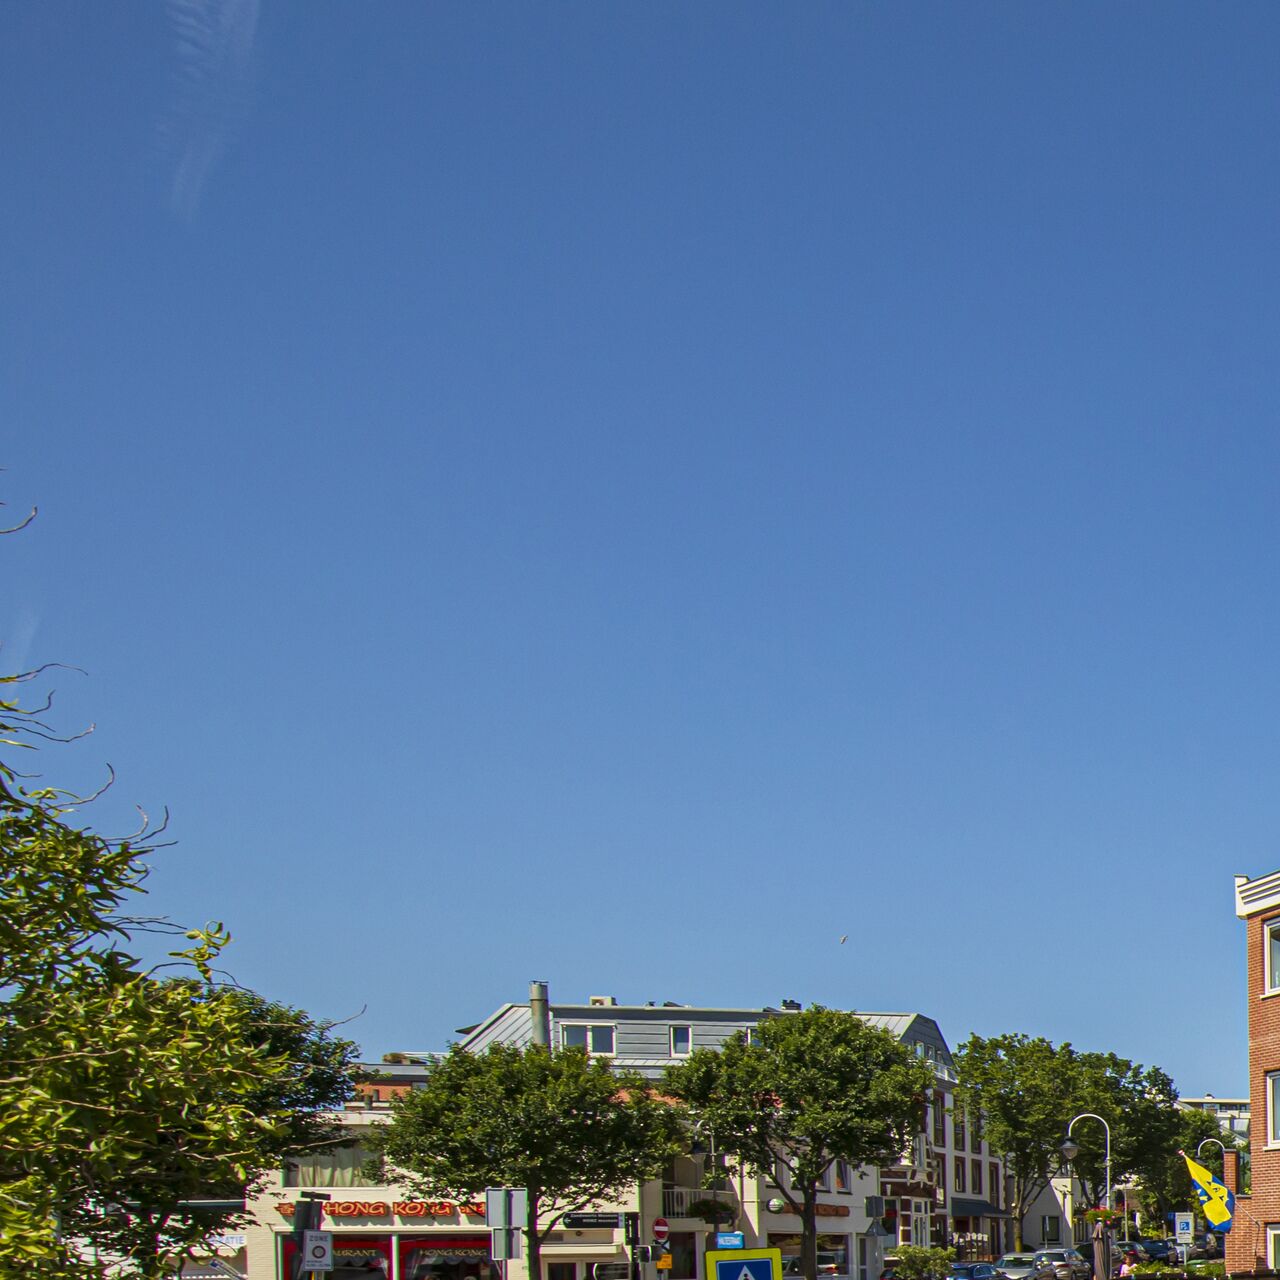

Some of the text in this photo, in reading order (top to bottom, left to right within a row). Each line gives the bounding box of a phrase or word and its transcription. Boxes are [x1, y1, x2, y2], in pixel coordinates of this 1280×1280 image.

[324, 1201, 386, 1216] HONG
[392, 1201, 454, 1216] KONG
[420, 1249, 488, 1257] HONG KONG
